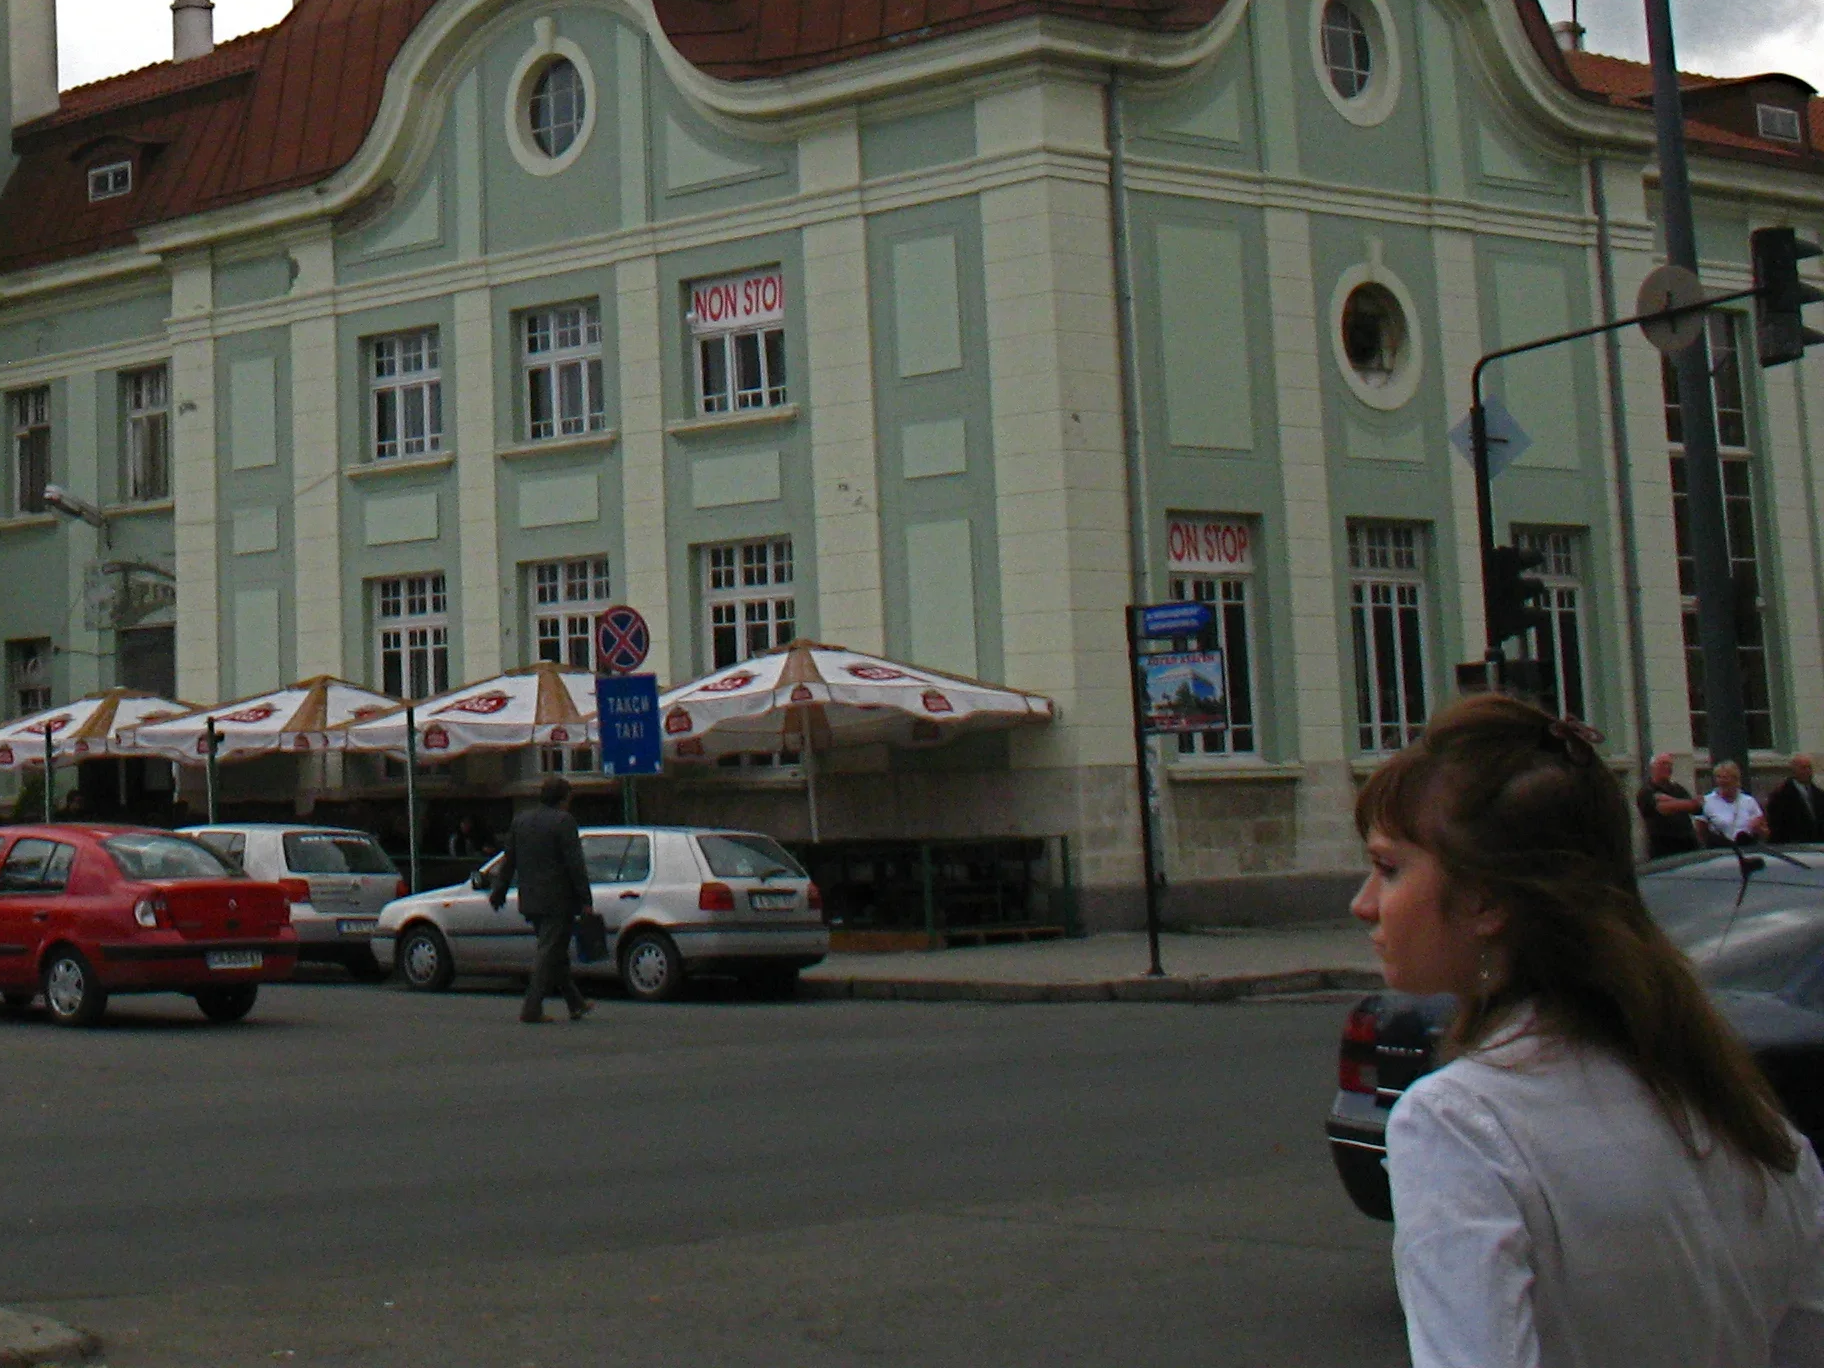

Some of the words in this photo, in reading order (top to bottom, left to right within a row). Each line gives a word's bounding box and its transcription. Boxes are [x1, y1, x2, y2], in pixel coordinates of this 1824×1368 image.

[694, 284, 738, 323] NON
[1166, 521, 1200, 562] ON
[1203, 523, 1249, 563] STOP
[607, 695, 651, 715] ТАКСИ
[614, 721, 644, 740] TAXI
